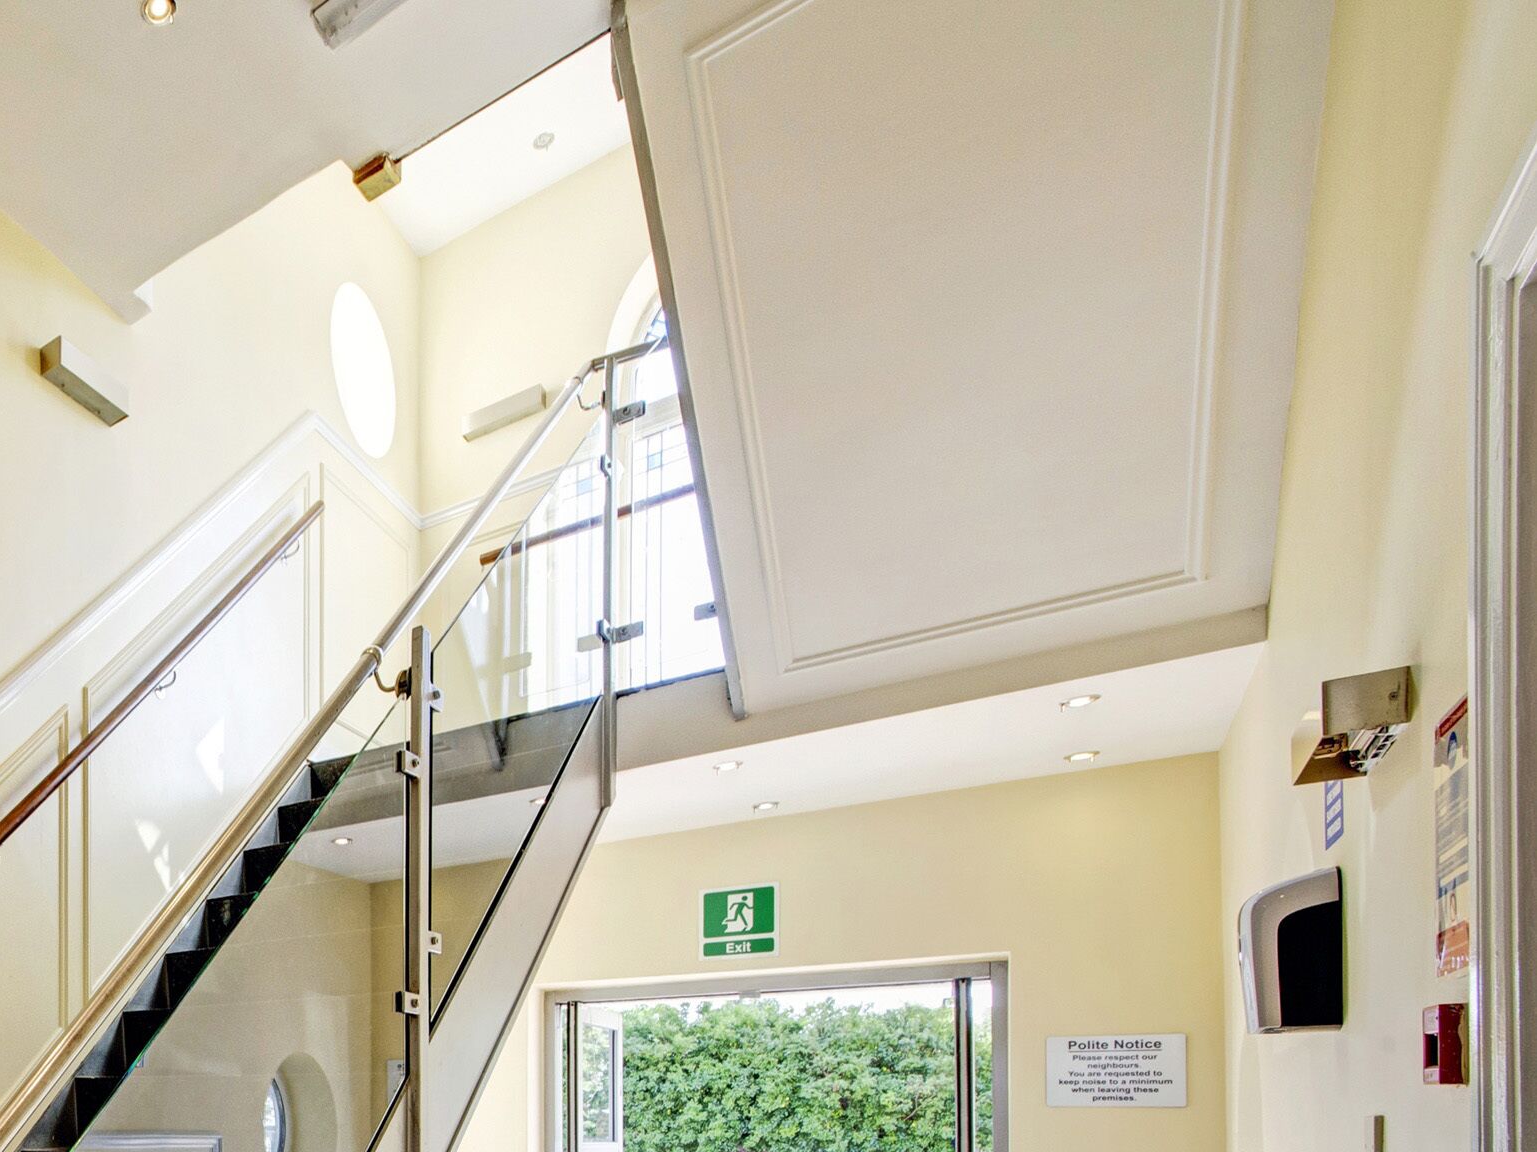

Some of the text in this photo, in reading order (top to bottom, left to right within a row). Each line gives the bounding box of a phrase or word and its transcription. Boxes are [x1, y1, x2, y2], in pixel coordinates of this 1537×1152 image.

[725, 941, 751, 954] Exit
[1067, 1039, 1162, 1050] Polite Notice
[1104, 1054, 1139, 1062] respect
[1104, 1070, 1150, 1078] requested
